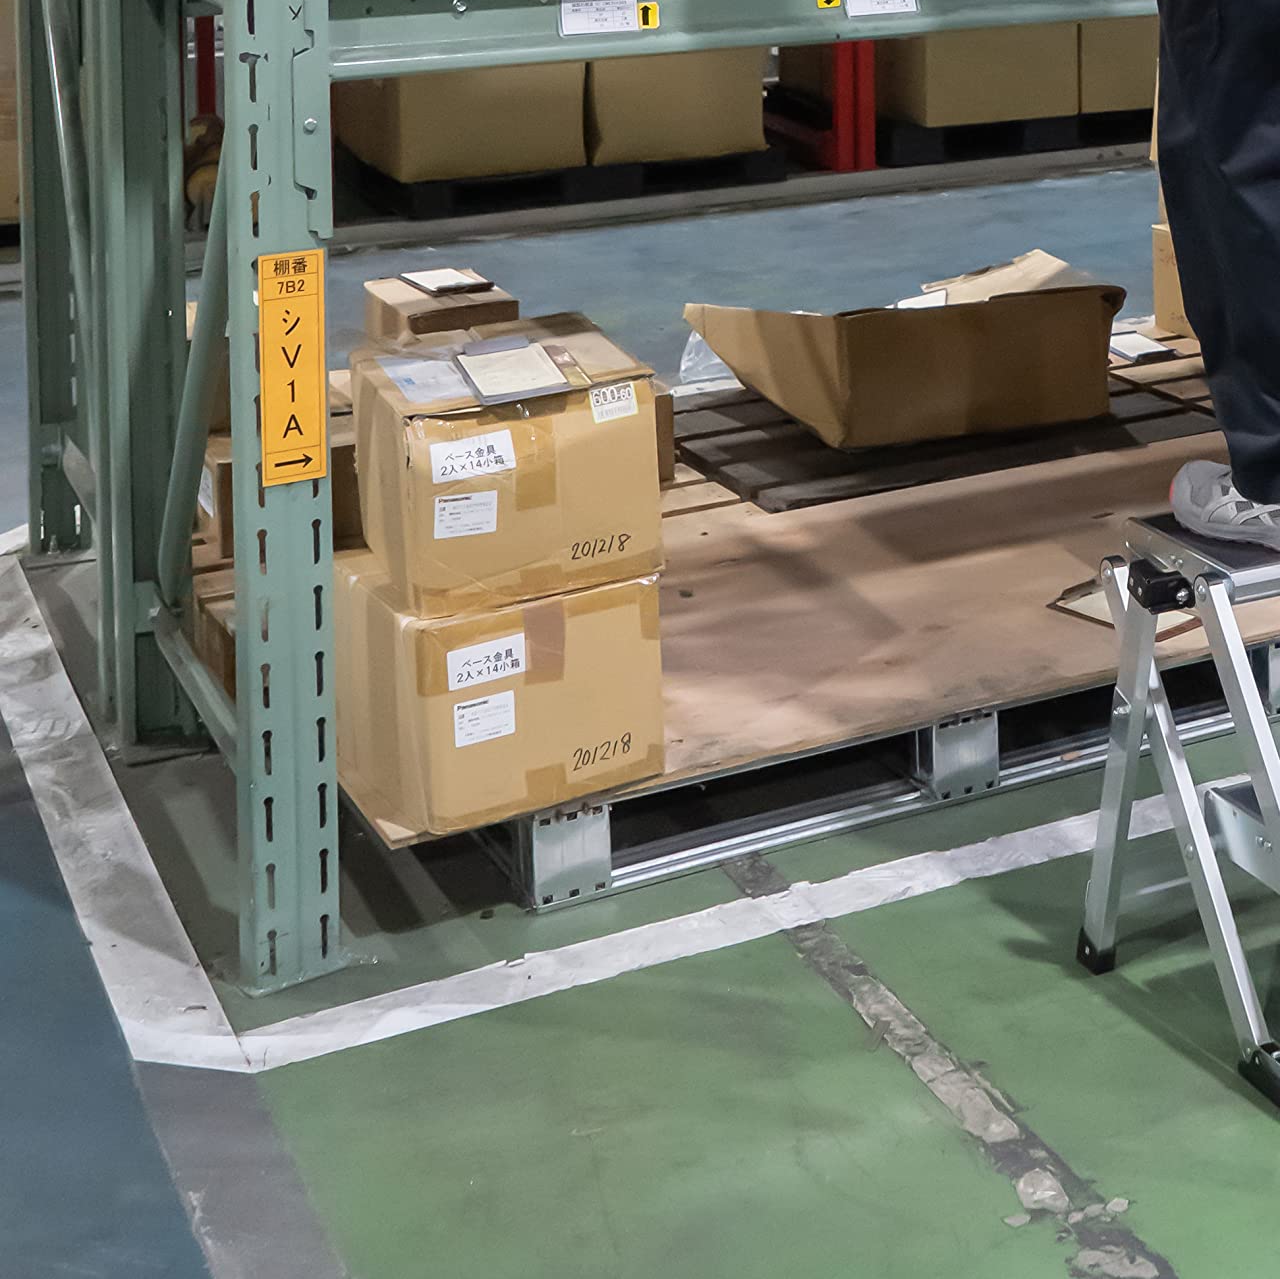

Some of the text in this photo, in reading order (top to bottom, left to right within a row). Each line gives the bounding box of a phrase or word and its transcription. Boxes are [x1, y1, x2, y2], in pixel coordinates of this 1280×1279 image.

[273, 257, 308, 276] 棚番
[277, 279, 305, 295] 7B2
[281, 309, 304, 439] シV1A
[444, 444, 497, 461] ベース金具
[461, 648, 514, 669] ベース金具
